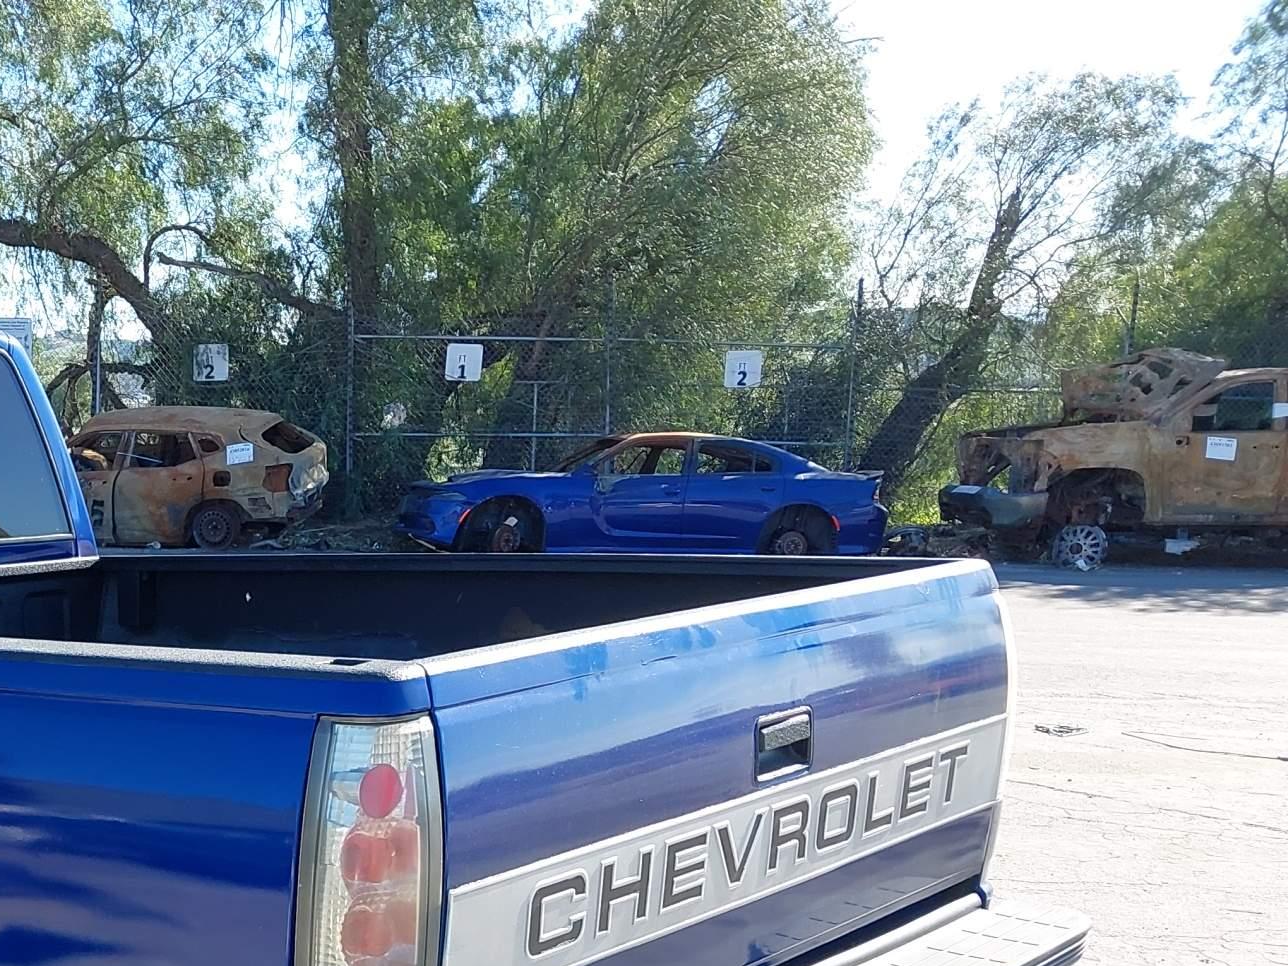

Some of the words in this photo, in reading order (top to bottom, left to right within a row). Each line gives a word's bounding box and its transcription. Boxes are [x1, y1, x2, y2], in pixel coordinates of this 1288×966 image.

[204, 364, 215, 379] 2
[457, 364, 467, 379] 1
[737, 370, 748, 386] 2
[527, 742, 970, 957] CHEVROLET
